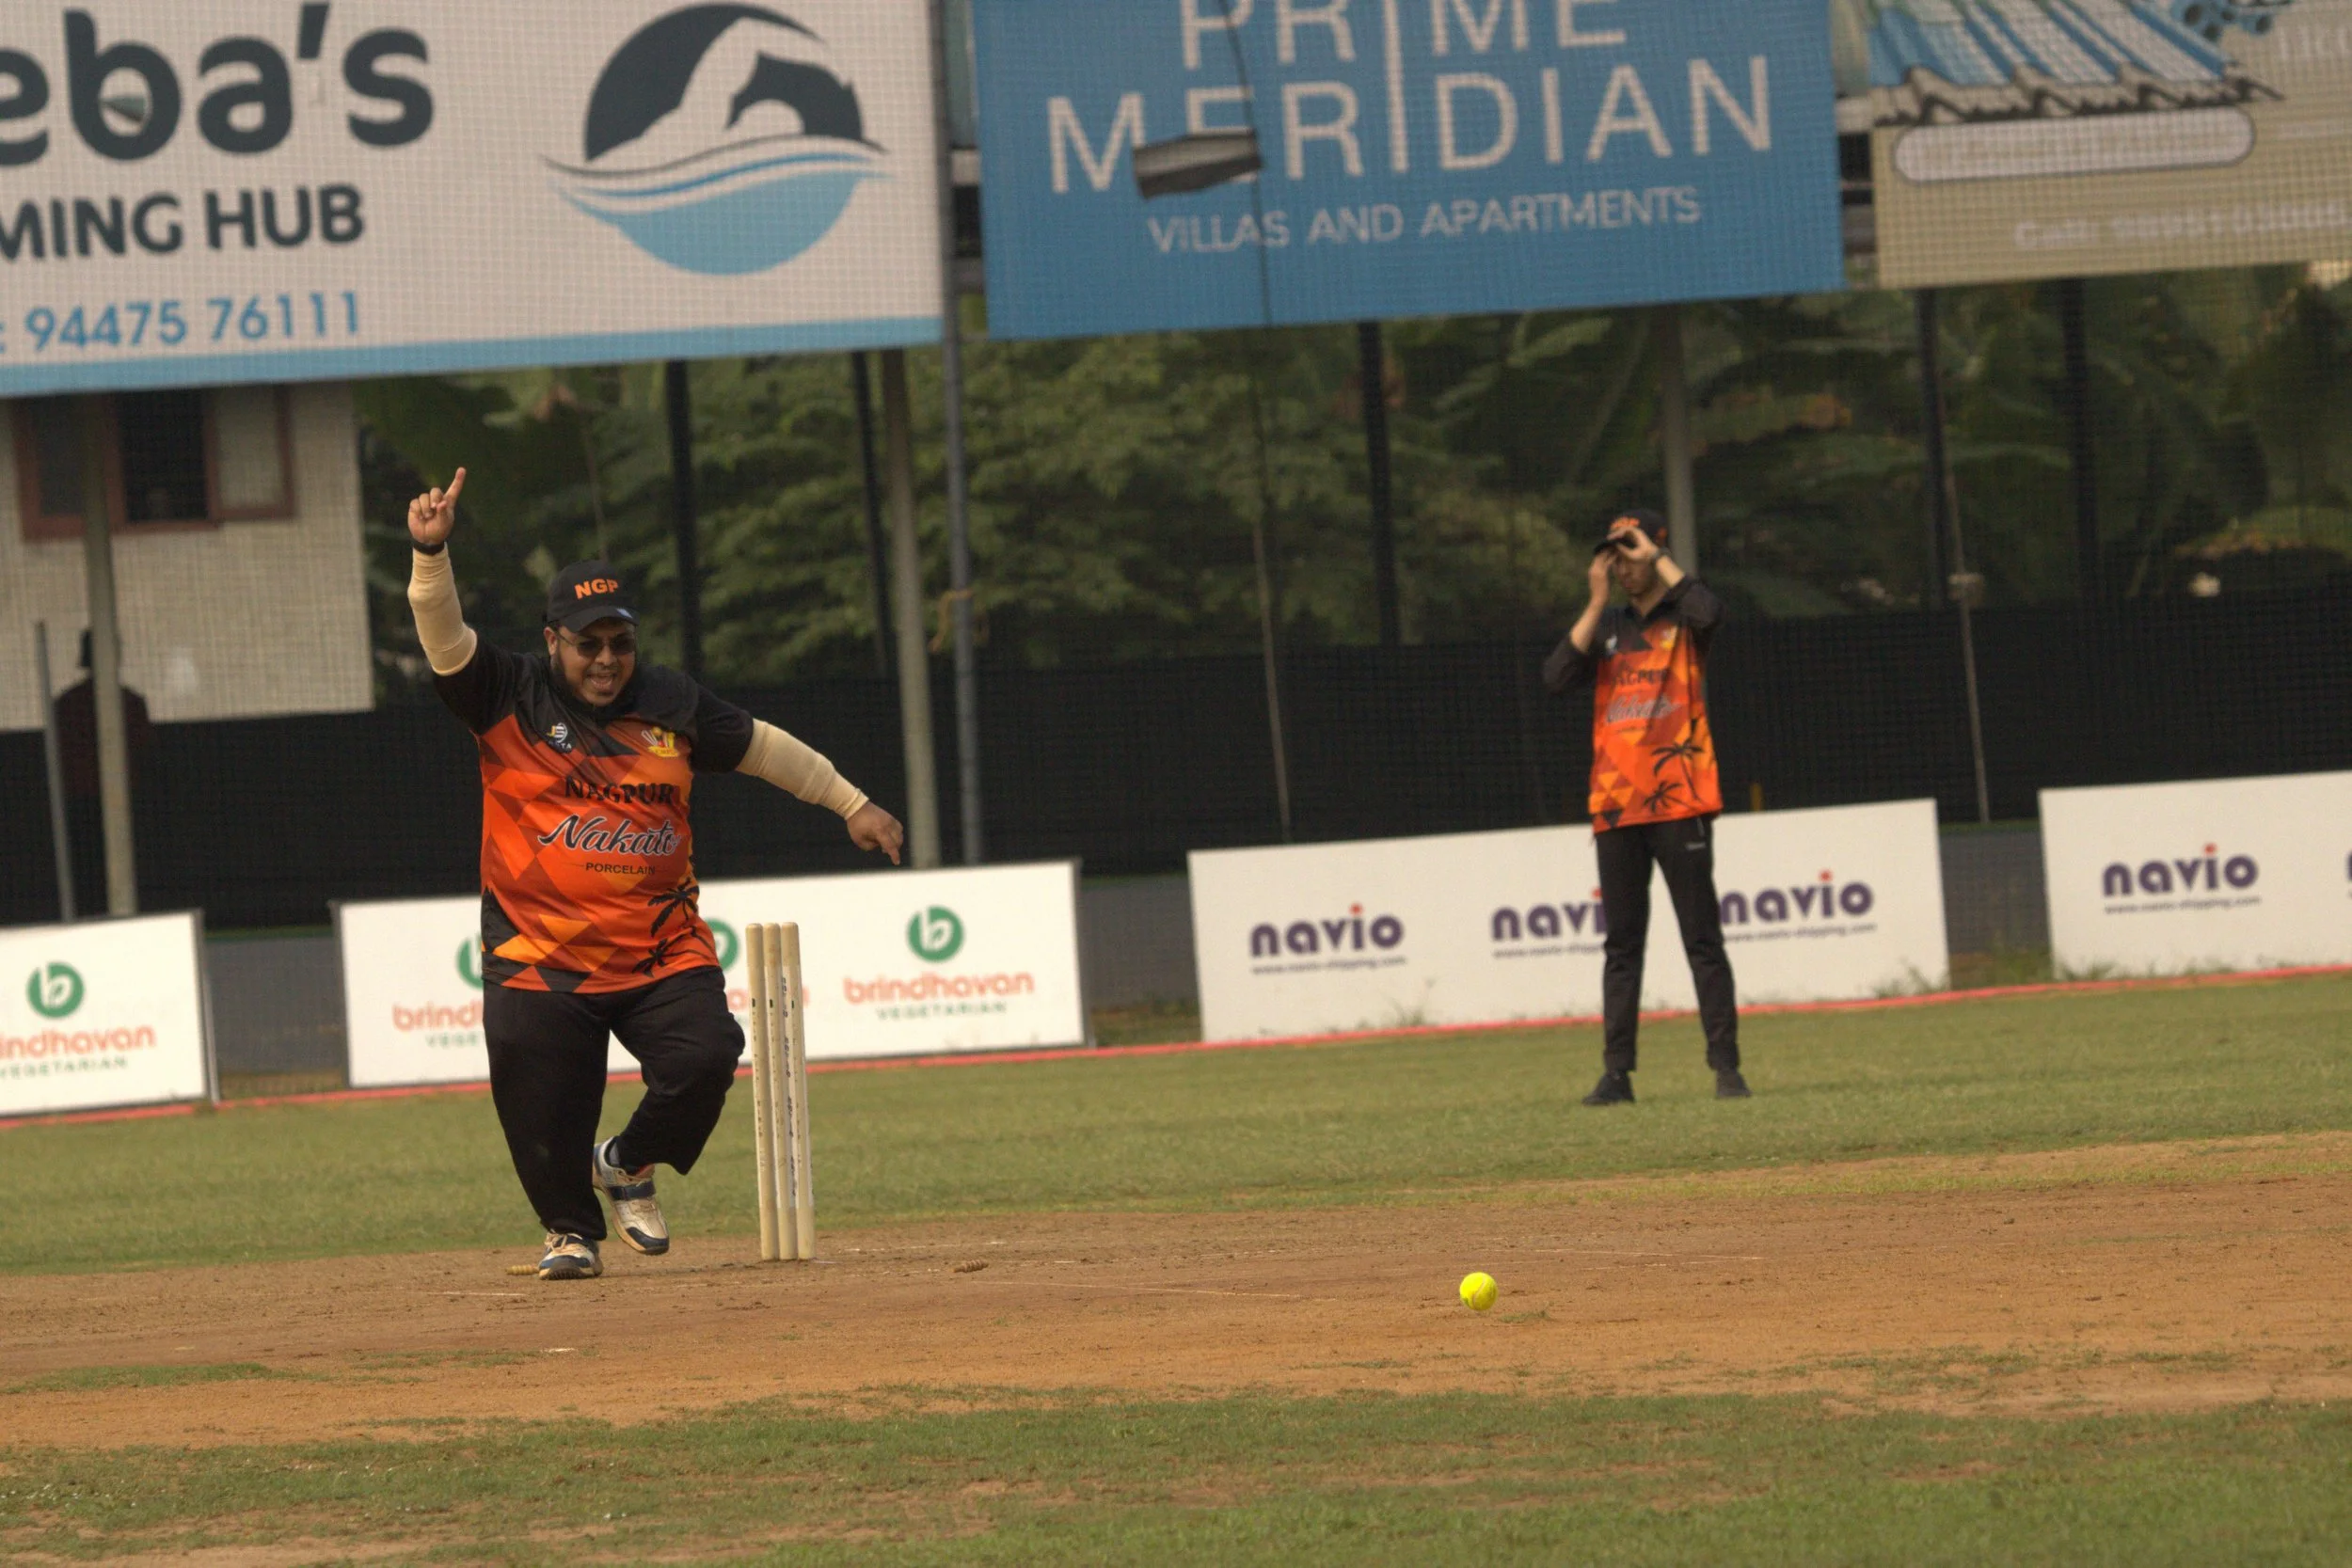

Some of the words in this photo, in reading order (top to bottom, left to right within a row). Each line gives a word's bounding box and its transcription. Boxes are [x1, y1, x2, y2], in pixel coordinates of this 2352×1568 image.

[1046, 55, 1772, 193] MERIDIAN
[0, 192, 183, 261] MING
[204, 182, 364, 250] HUB
[1147, 210, 1291, 253] VILLAS
[1308, 203, 1406, 245] AND
[1420, 186, 1703, 238] APARTMENTS
[24, 299, 187, 353] 94475
[208, 291, 359, 342] 76111
[574, 578, 619, 599] NGP
[565, 775, 675, 804] NAGPUR
[585, 863, 656, 875] PORCELAIN
[1720, 868, 1873, 925] navio
[2101, 843, 2260, 896] navio
[1250, 902, 1404, 958] navio
[1492, 887, 1607, 942] navi
[391, 1001, 483, 1031] brind
[844, 972, 1035, 1006] brindhavan
